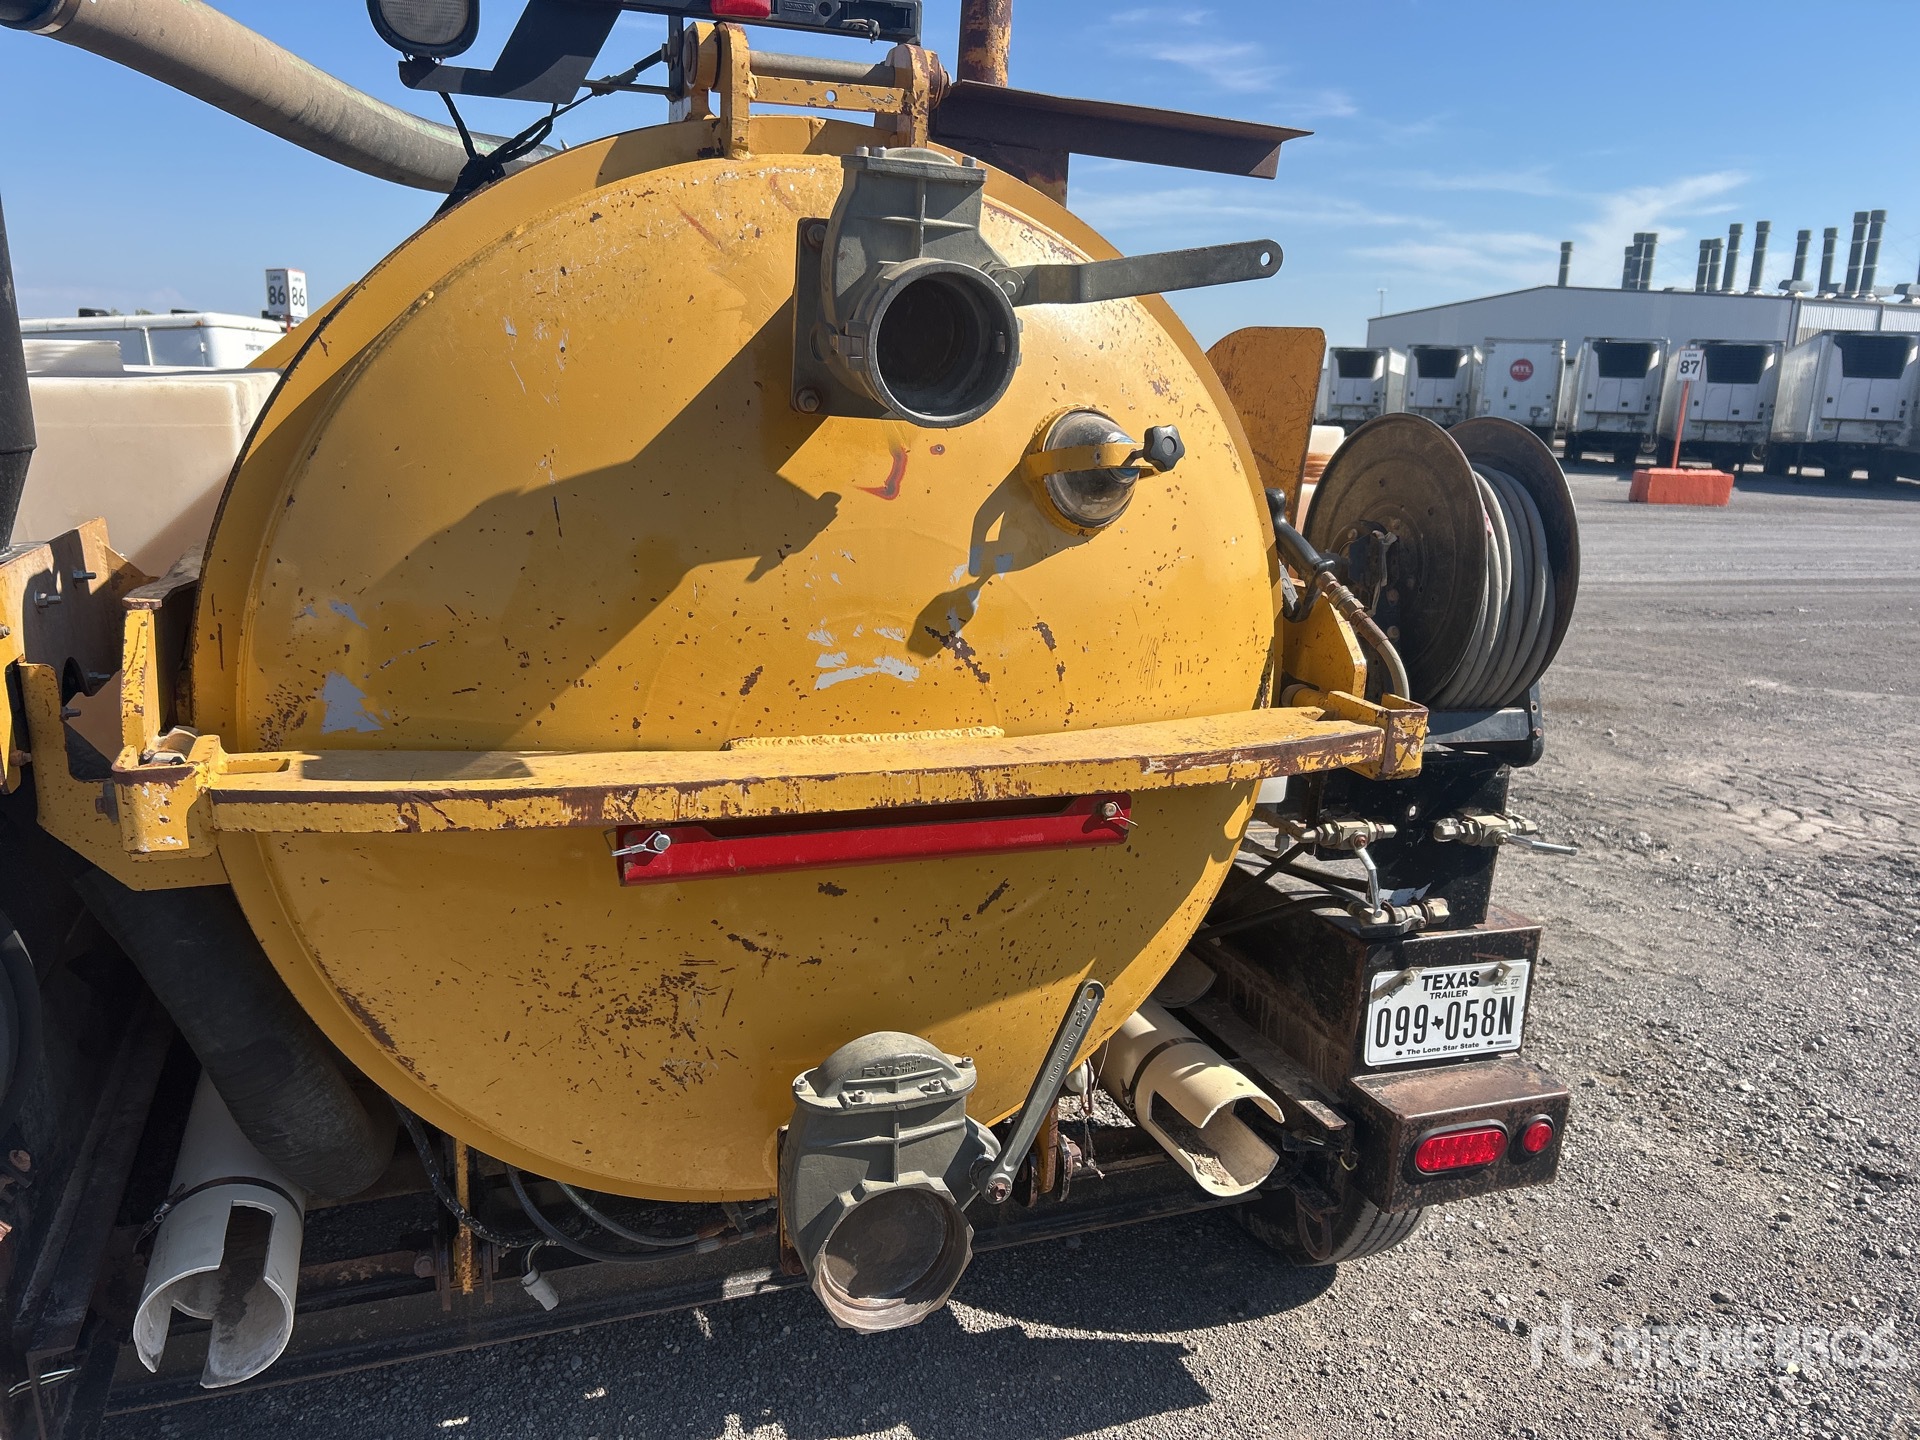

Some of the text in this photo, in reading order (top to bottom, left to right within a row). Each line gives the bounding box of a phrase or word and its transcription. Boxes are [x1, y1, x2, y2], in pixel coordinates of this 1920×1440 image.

[268, 285, 286, 305] 86
[292, 286, 306, 307] 86
[1680, 360, 1700, 374] 87
[1421, 970, 1480, 992] TEXAS
[1429, 989, 1469, 1000] TRAILER
[1406, 1048, 1421, 1056] The
[1422, 1046, 1441, 1054] Lone
[1460, 1042, 1480, 1050] State
